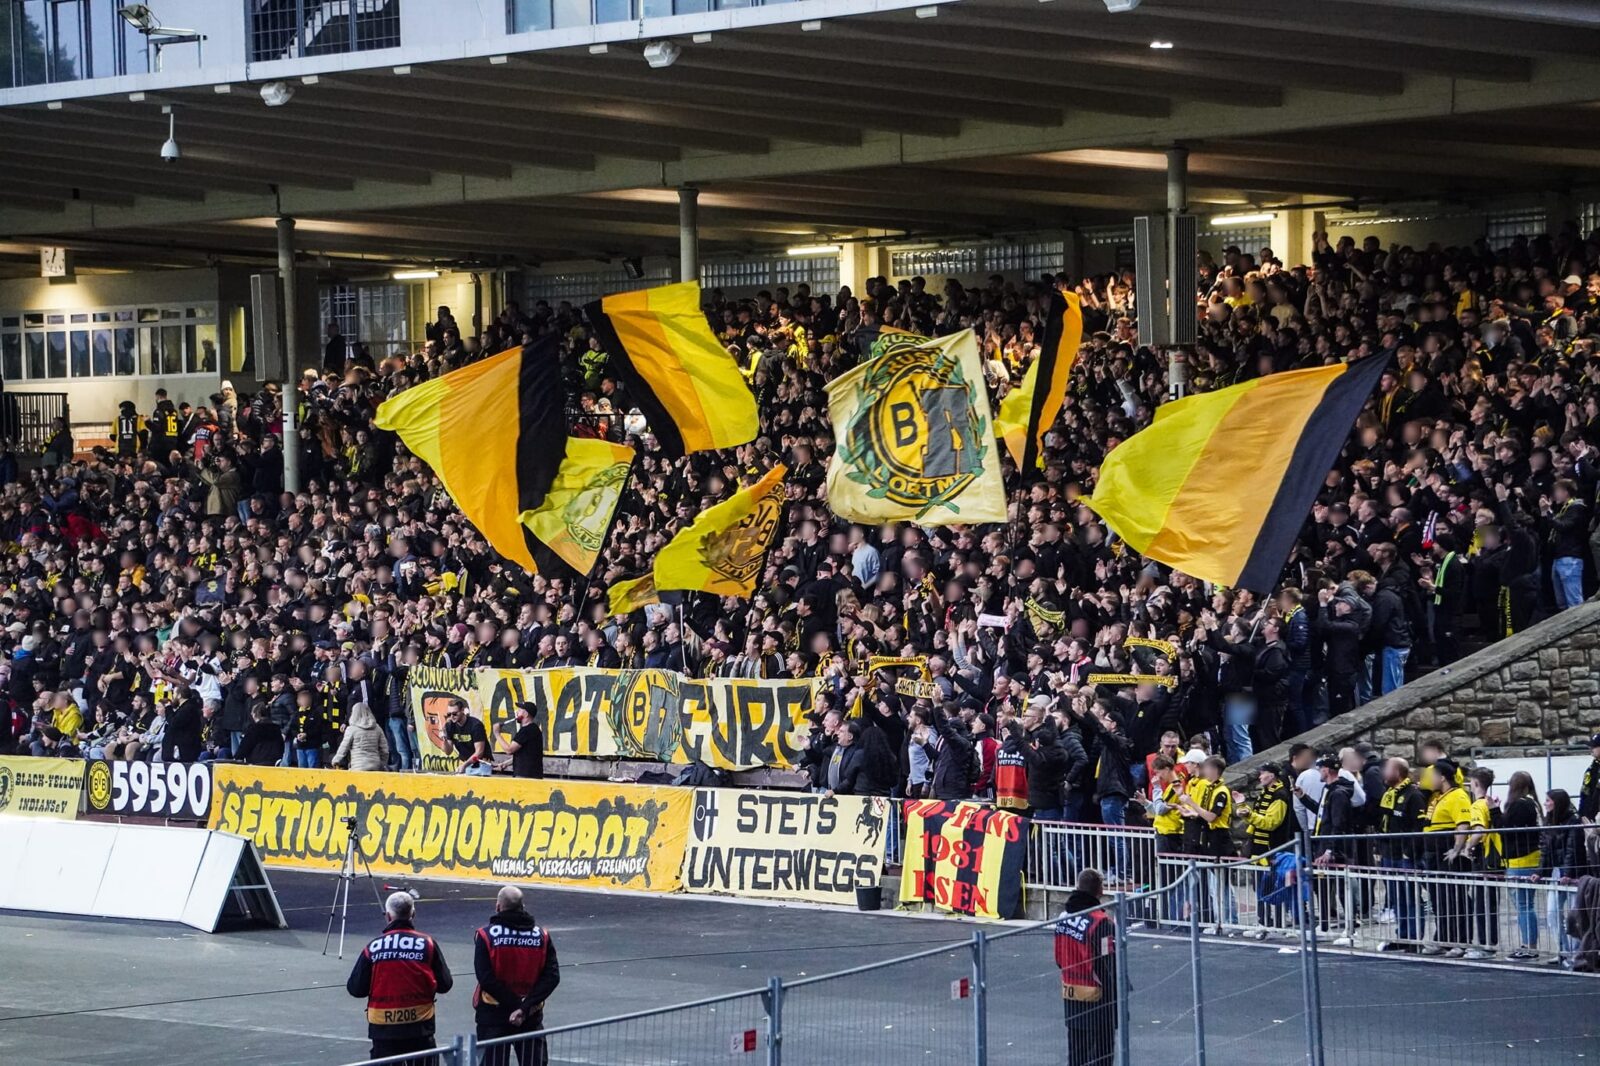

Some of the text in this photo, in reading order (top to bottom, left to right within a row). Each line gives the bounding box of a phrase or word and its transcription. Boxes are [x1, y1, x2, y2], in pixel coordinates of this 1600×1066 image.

[121, 418, 134, 434] 11
[167, 415, 178, 432] 16
[15, 772, 84, 790] BLACK-YELLOW
[112, 760, 211, 816] 59590
[736, 794, 839, 834] STETS
[220, 791, 649, 863] SEKTION STADIONVERBOT
[919, 830, 985, 874] 1981
[492, 857, 648, 876] NIEMALS VERZAGEN FREUNDE!
[688, 846, 878, 893] UNTERWEGS
[369, 933, 425, 953] atlas
[493, 938, 541, 947] SAFETY SHOES
[371, 951, 424, 962] SAFETY SHOES
[384, 1009, 417, 1022] R/208
